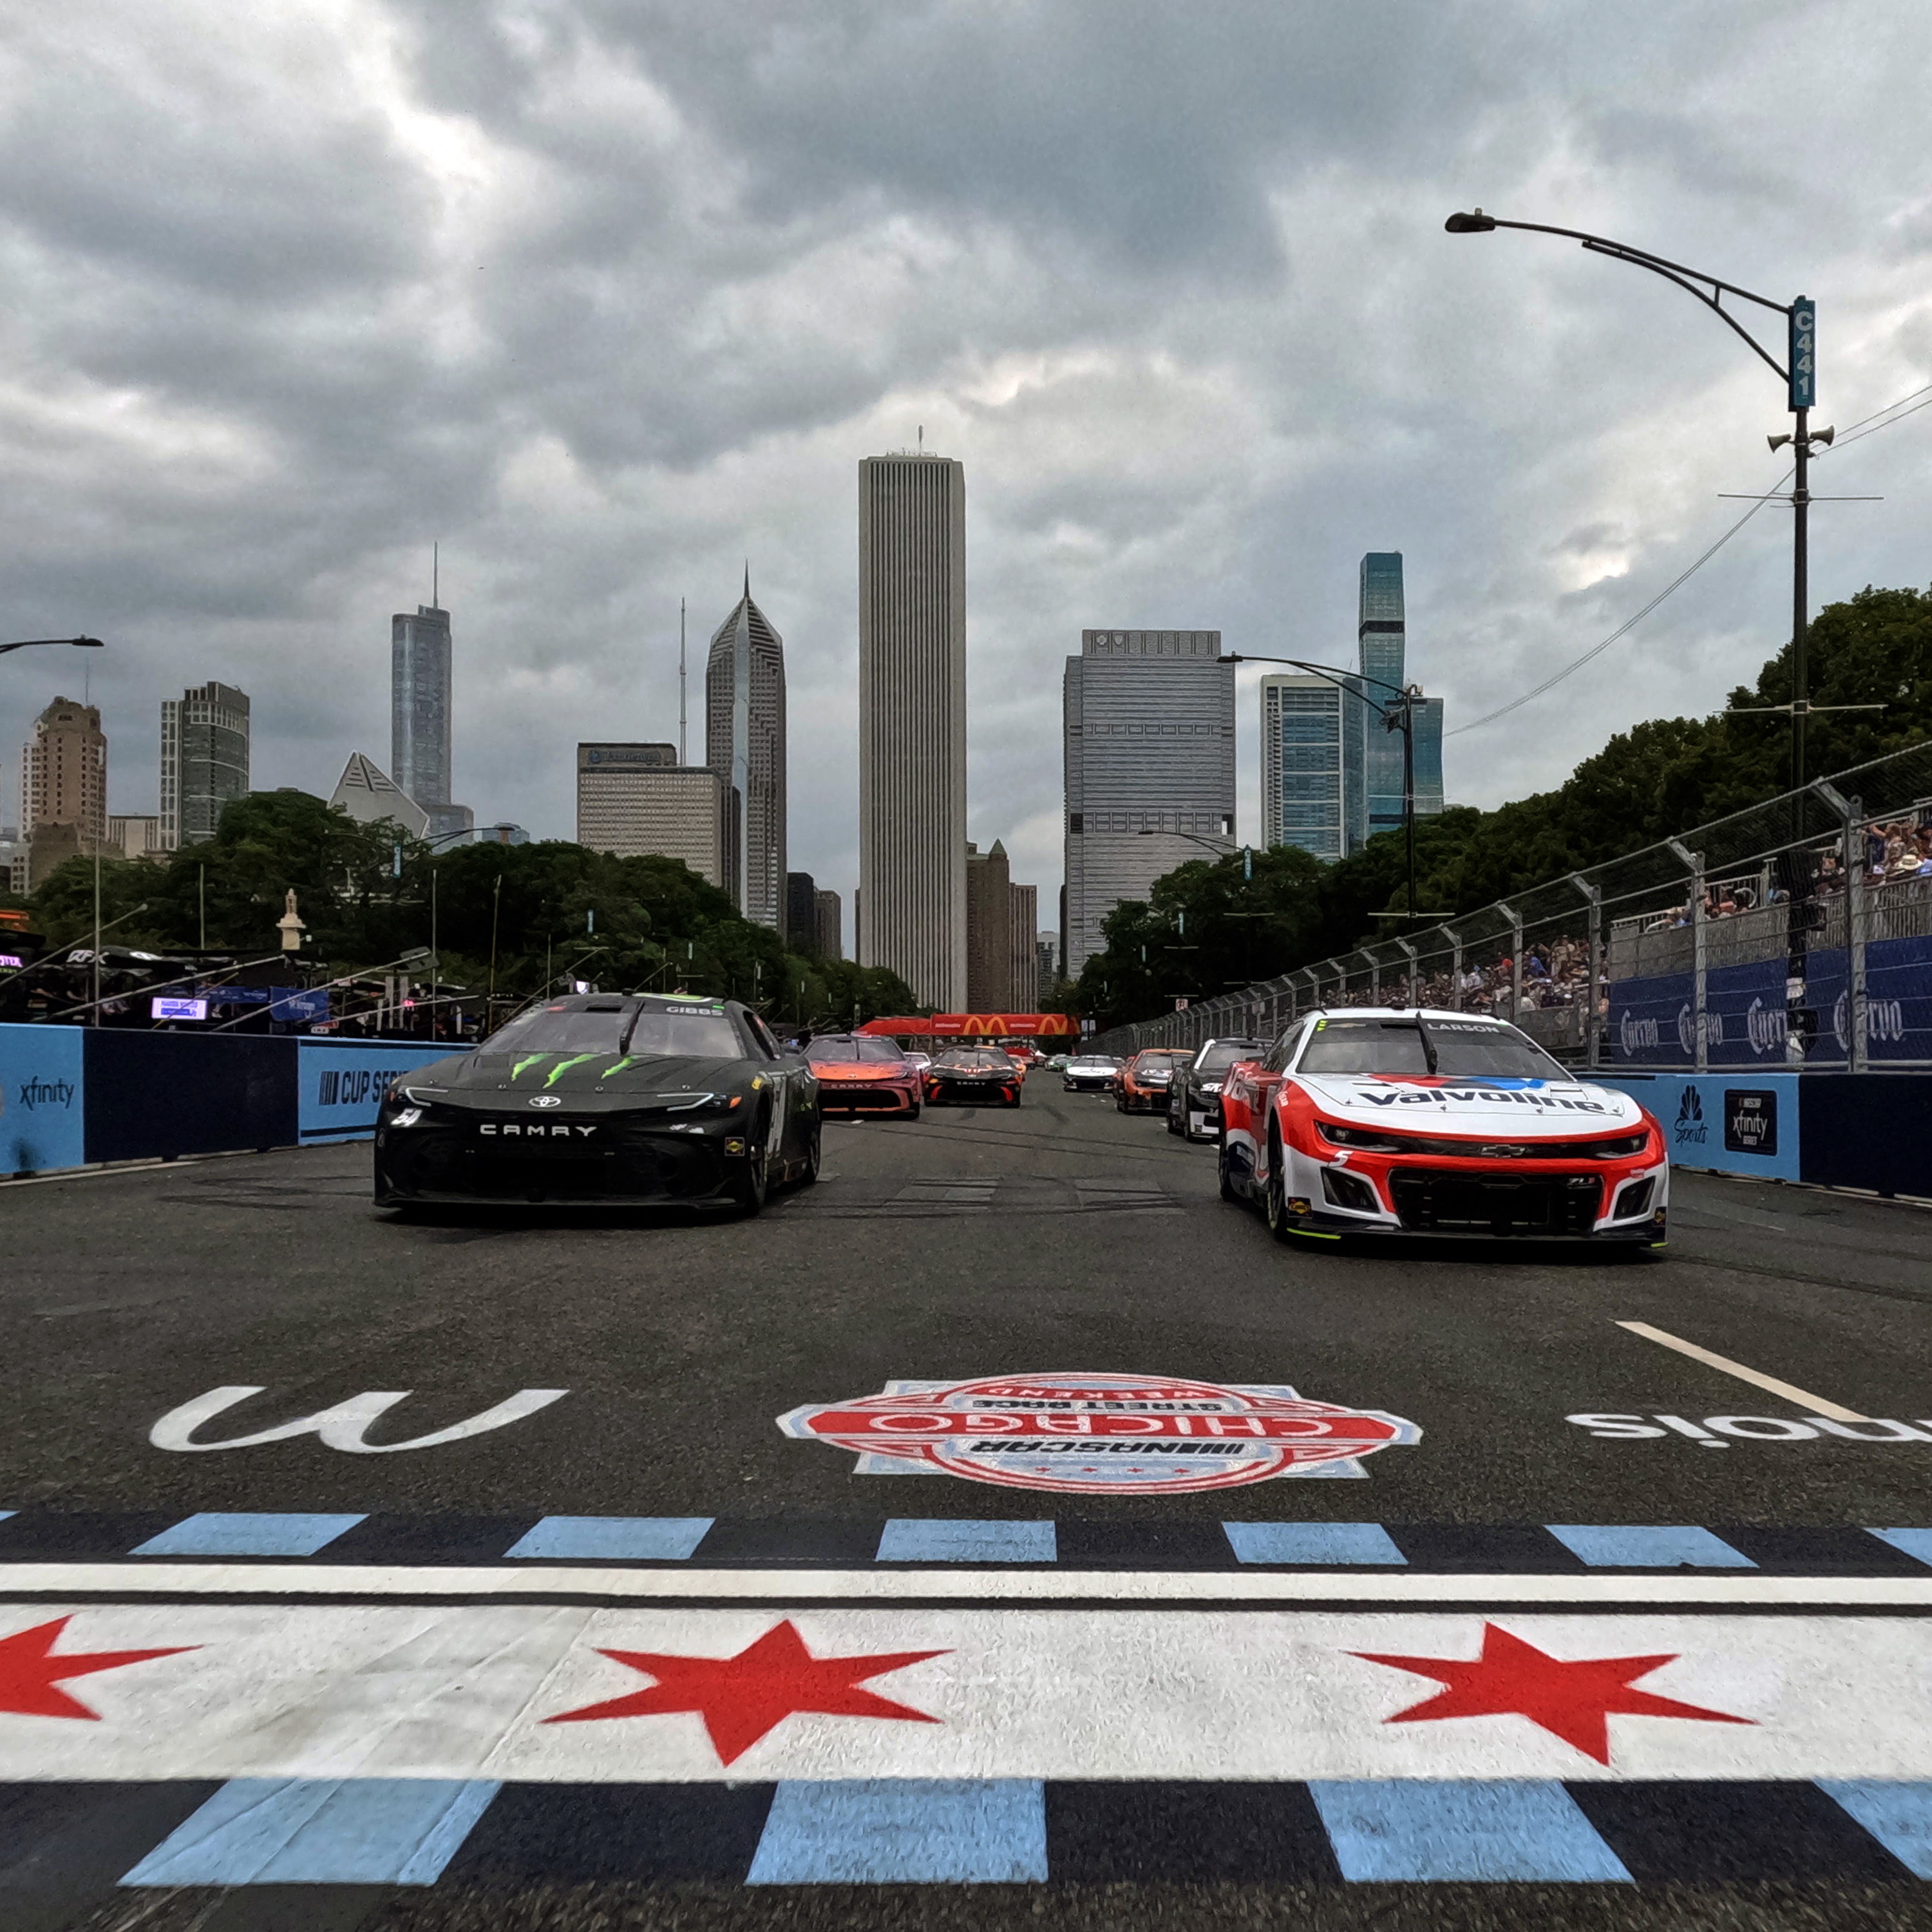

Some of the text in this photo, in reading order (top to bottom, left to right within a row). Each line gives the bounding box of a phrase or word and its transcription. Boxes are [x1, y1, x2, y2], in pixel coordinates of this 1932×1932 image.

[1795, 310, 1814, 395] C441
[666, 1006, 723, 1016] GIBBS
[1834, 990, 1902, 1052] Crvo
[1427, 1023, 1500, 1033] LARSON
[19, 1075, 75, 1111] xfinity
[341, 1070, 370, 1104] CUP
[1358, 1090, 1606, 1114] Valvoline
[480, 1124, 597, 1137] CAMRY
[1674, 1117, 1710, 1148] Sports
[1733, 1110, 1768, 1141] xfinity
[1329, 1150, 1354, 1166] 5
[972, 1399, 1222, 1411] STREET RACE
[989, 1388, 1206, 1399] WEEKEND
[869, 1414, 1333, 1437] CHICAGO
[1565, 1414, 1932, 1448] nois
[971, 1441, 1179, 1454] NASCAR
